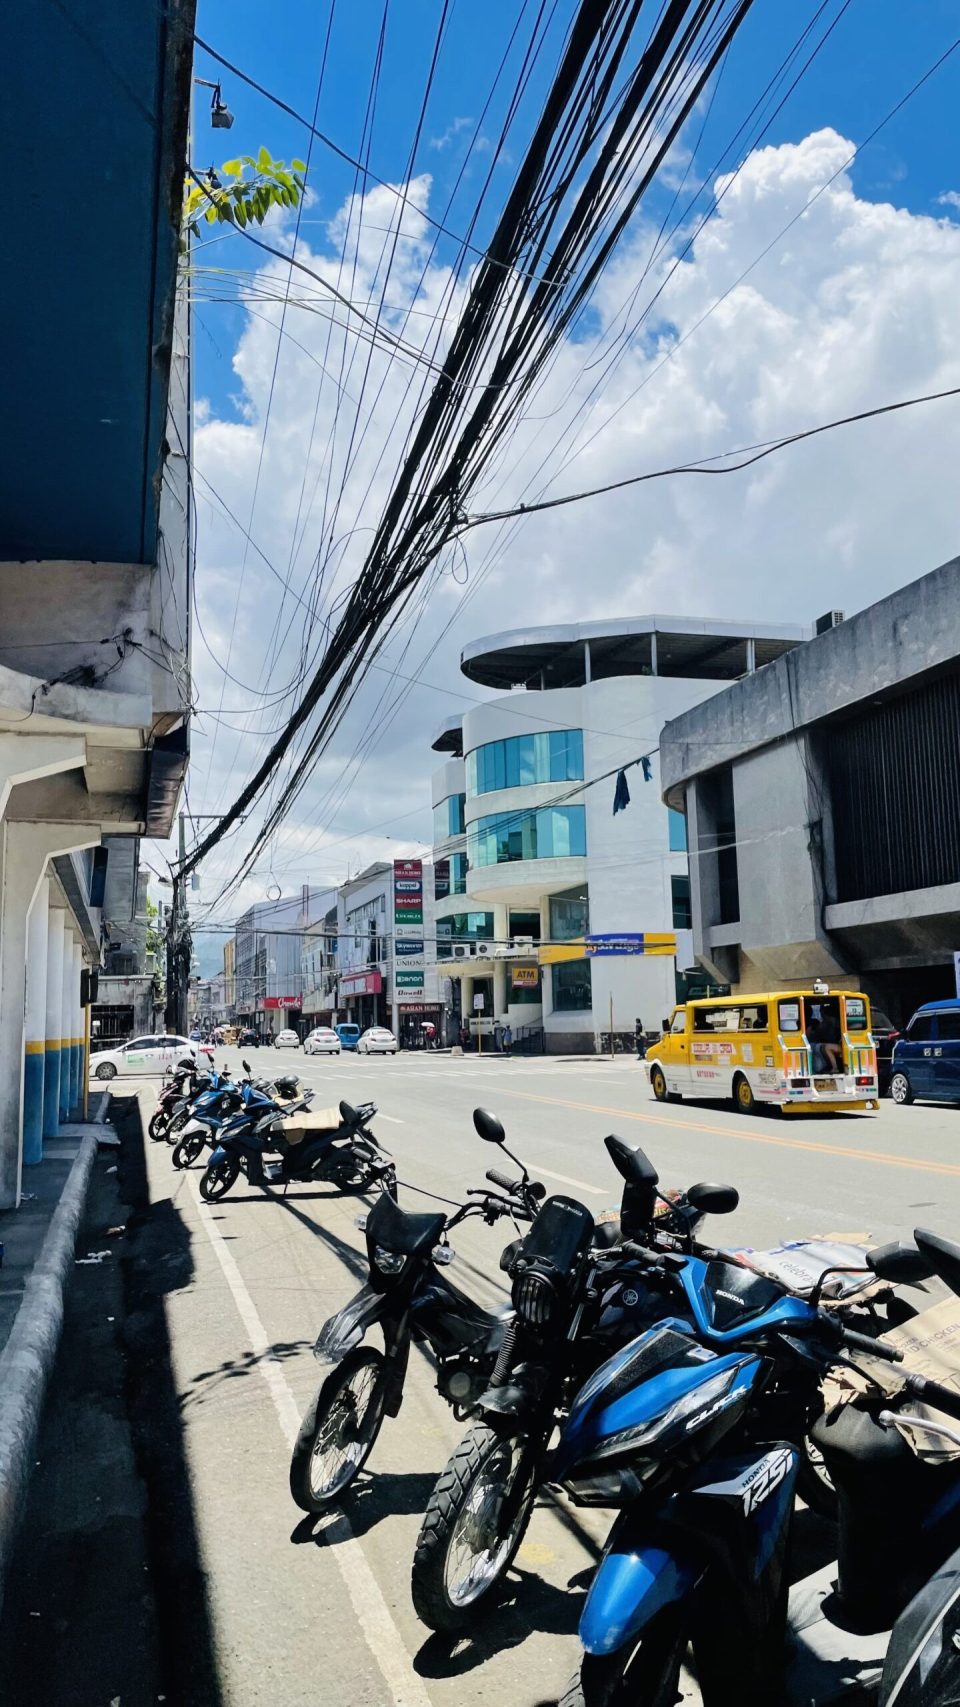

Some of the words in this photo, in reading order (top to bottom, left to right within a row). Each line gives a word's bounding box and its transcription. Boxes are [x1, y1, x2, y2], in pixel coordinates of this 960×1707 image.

[516, 970, 535, 979] ATM
[406, 1004, 424, 1012] ASIAN
[715, 1289, 745, 1306] HONDA
[742, 1458, 770, 1489] HONDA
